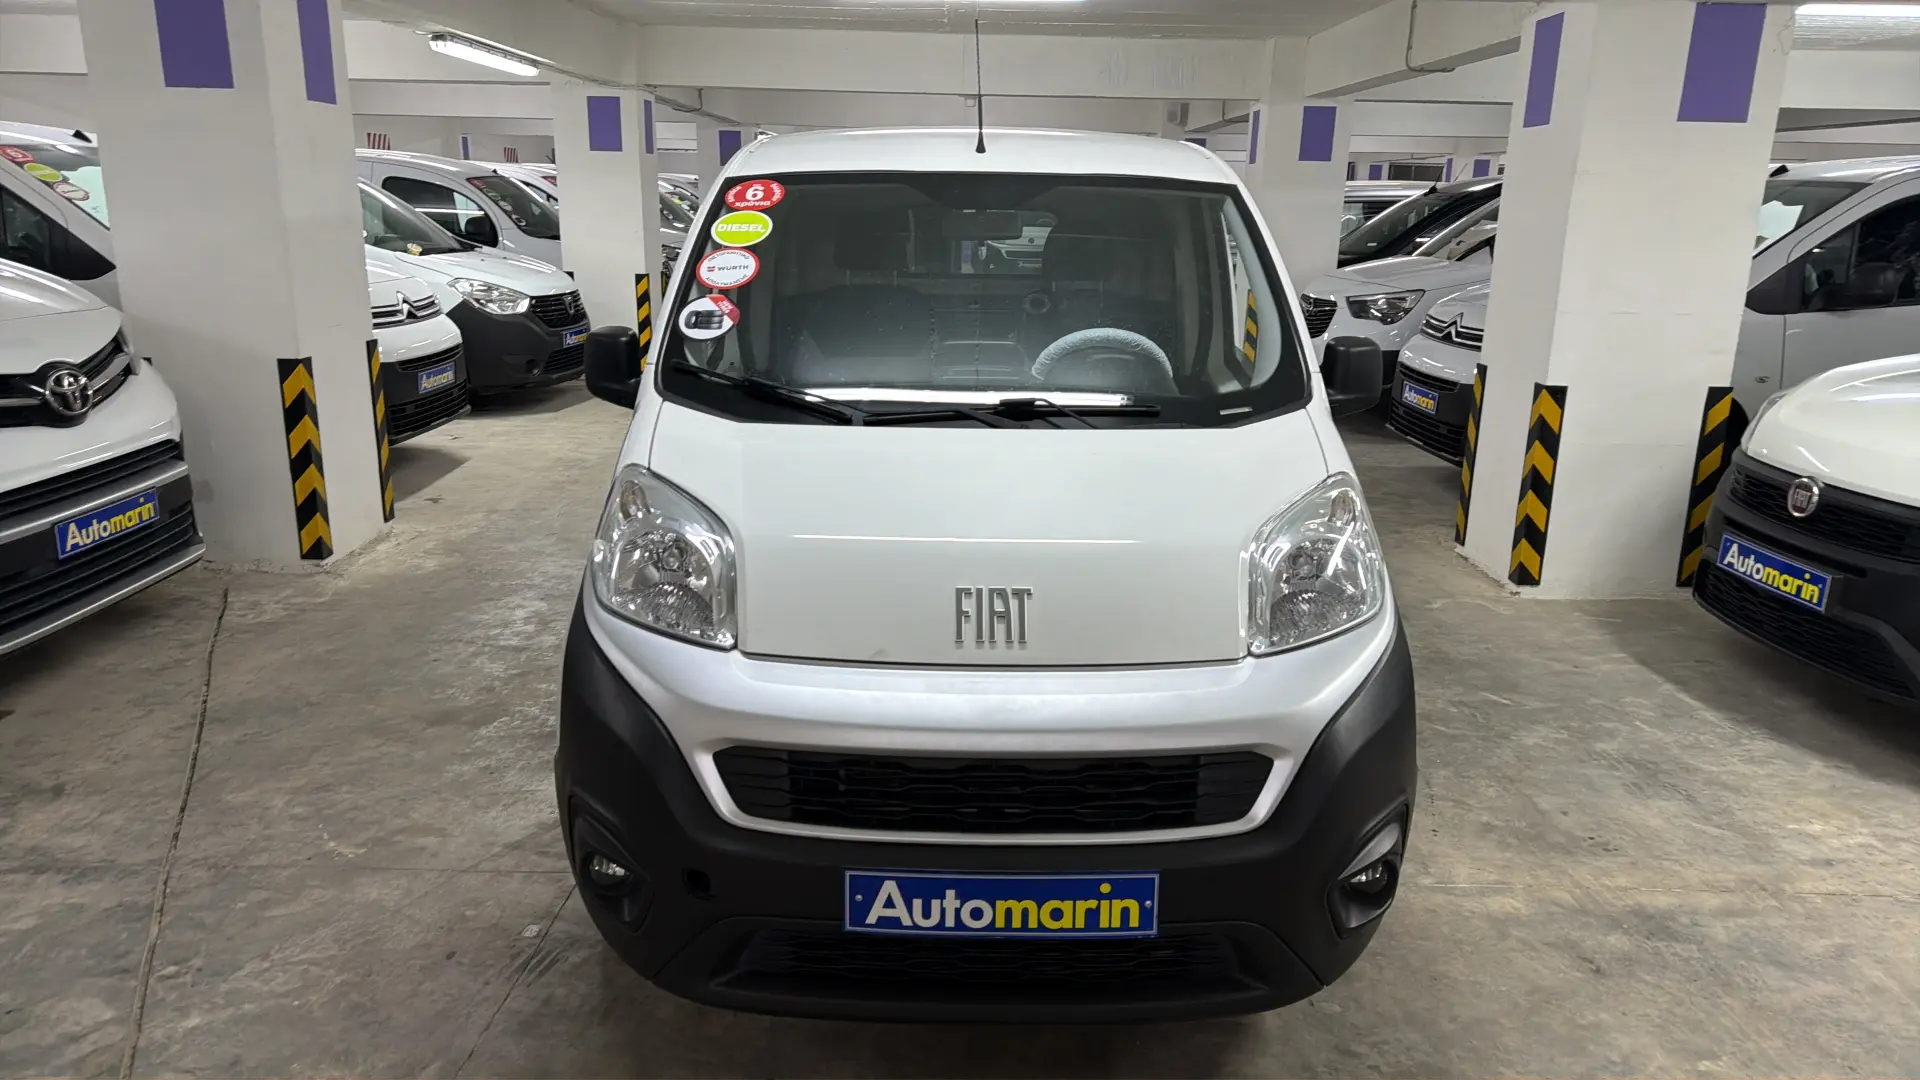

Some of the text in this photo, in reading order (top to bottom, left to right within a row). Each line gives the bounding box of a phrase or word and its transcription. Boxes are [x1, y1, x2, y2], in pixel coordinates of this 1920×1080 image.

[745, 186, 765, 201] 6
[717, 223, 766, 233] DIESEL
[65, 497, 155, 552] Automarin
[1723, 543, 1820, 604] Automarin
[955, 586, 1033, 644] FIAT
[865, 879, 1140, 929] Automarin
